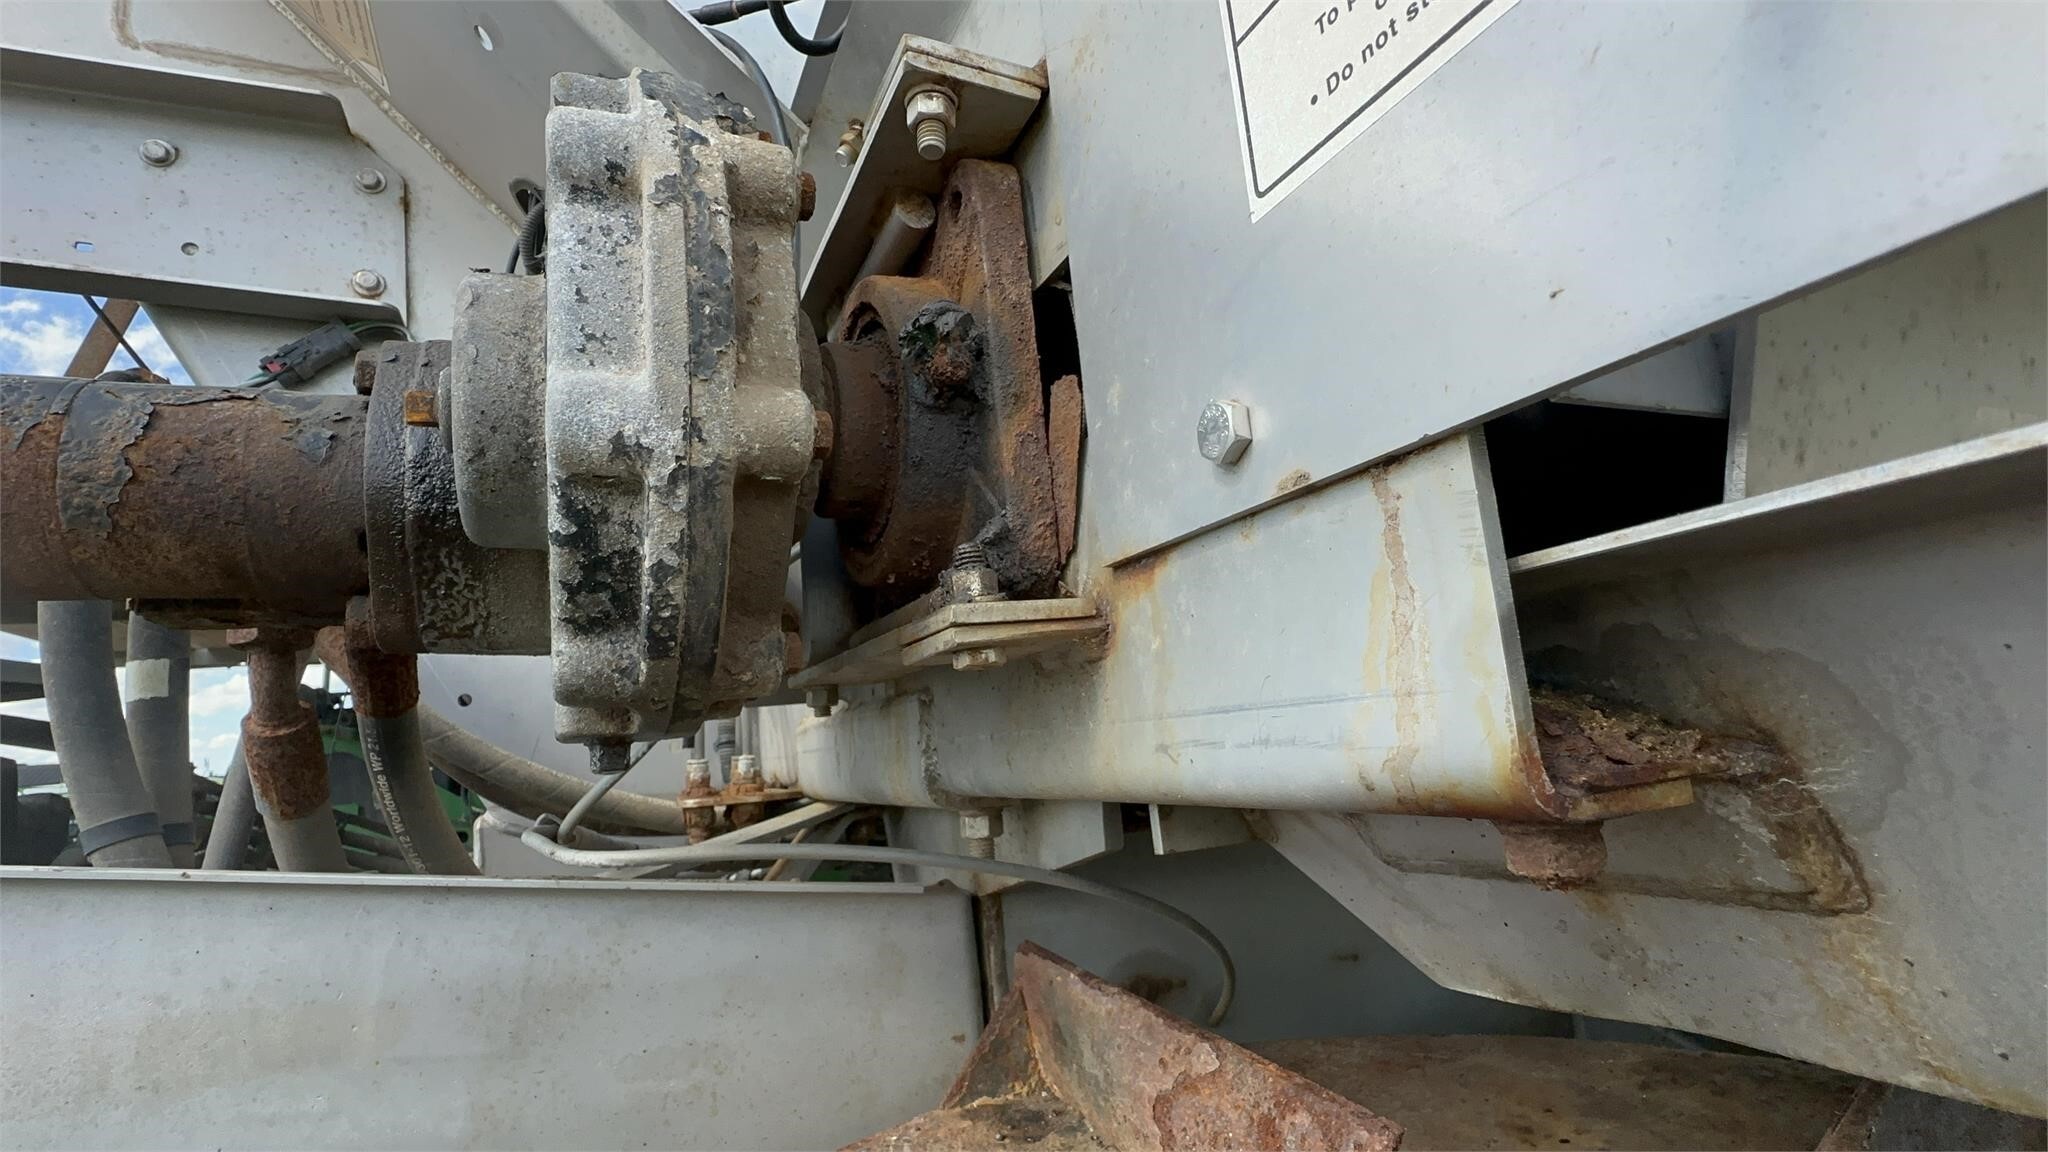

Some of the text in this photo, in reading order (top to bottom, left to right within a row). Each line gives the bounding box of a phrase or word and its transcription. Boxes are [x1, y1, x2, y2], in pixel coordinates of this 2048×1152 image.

[1314, 6, 1339, 35] To
[1326, 62, 1354, 97] Do
[1361, 17, 1399, 64] not
[369, 752, 384, 772] WP
[376, 774, 405, 834] Worldwide
